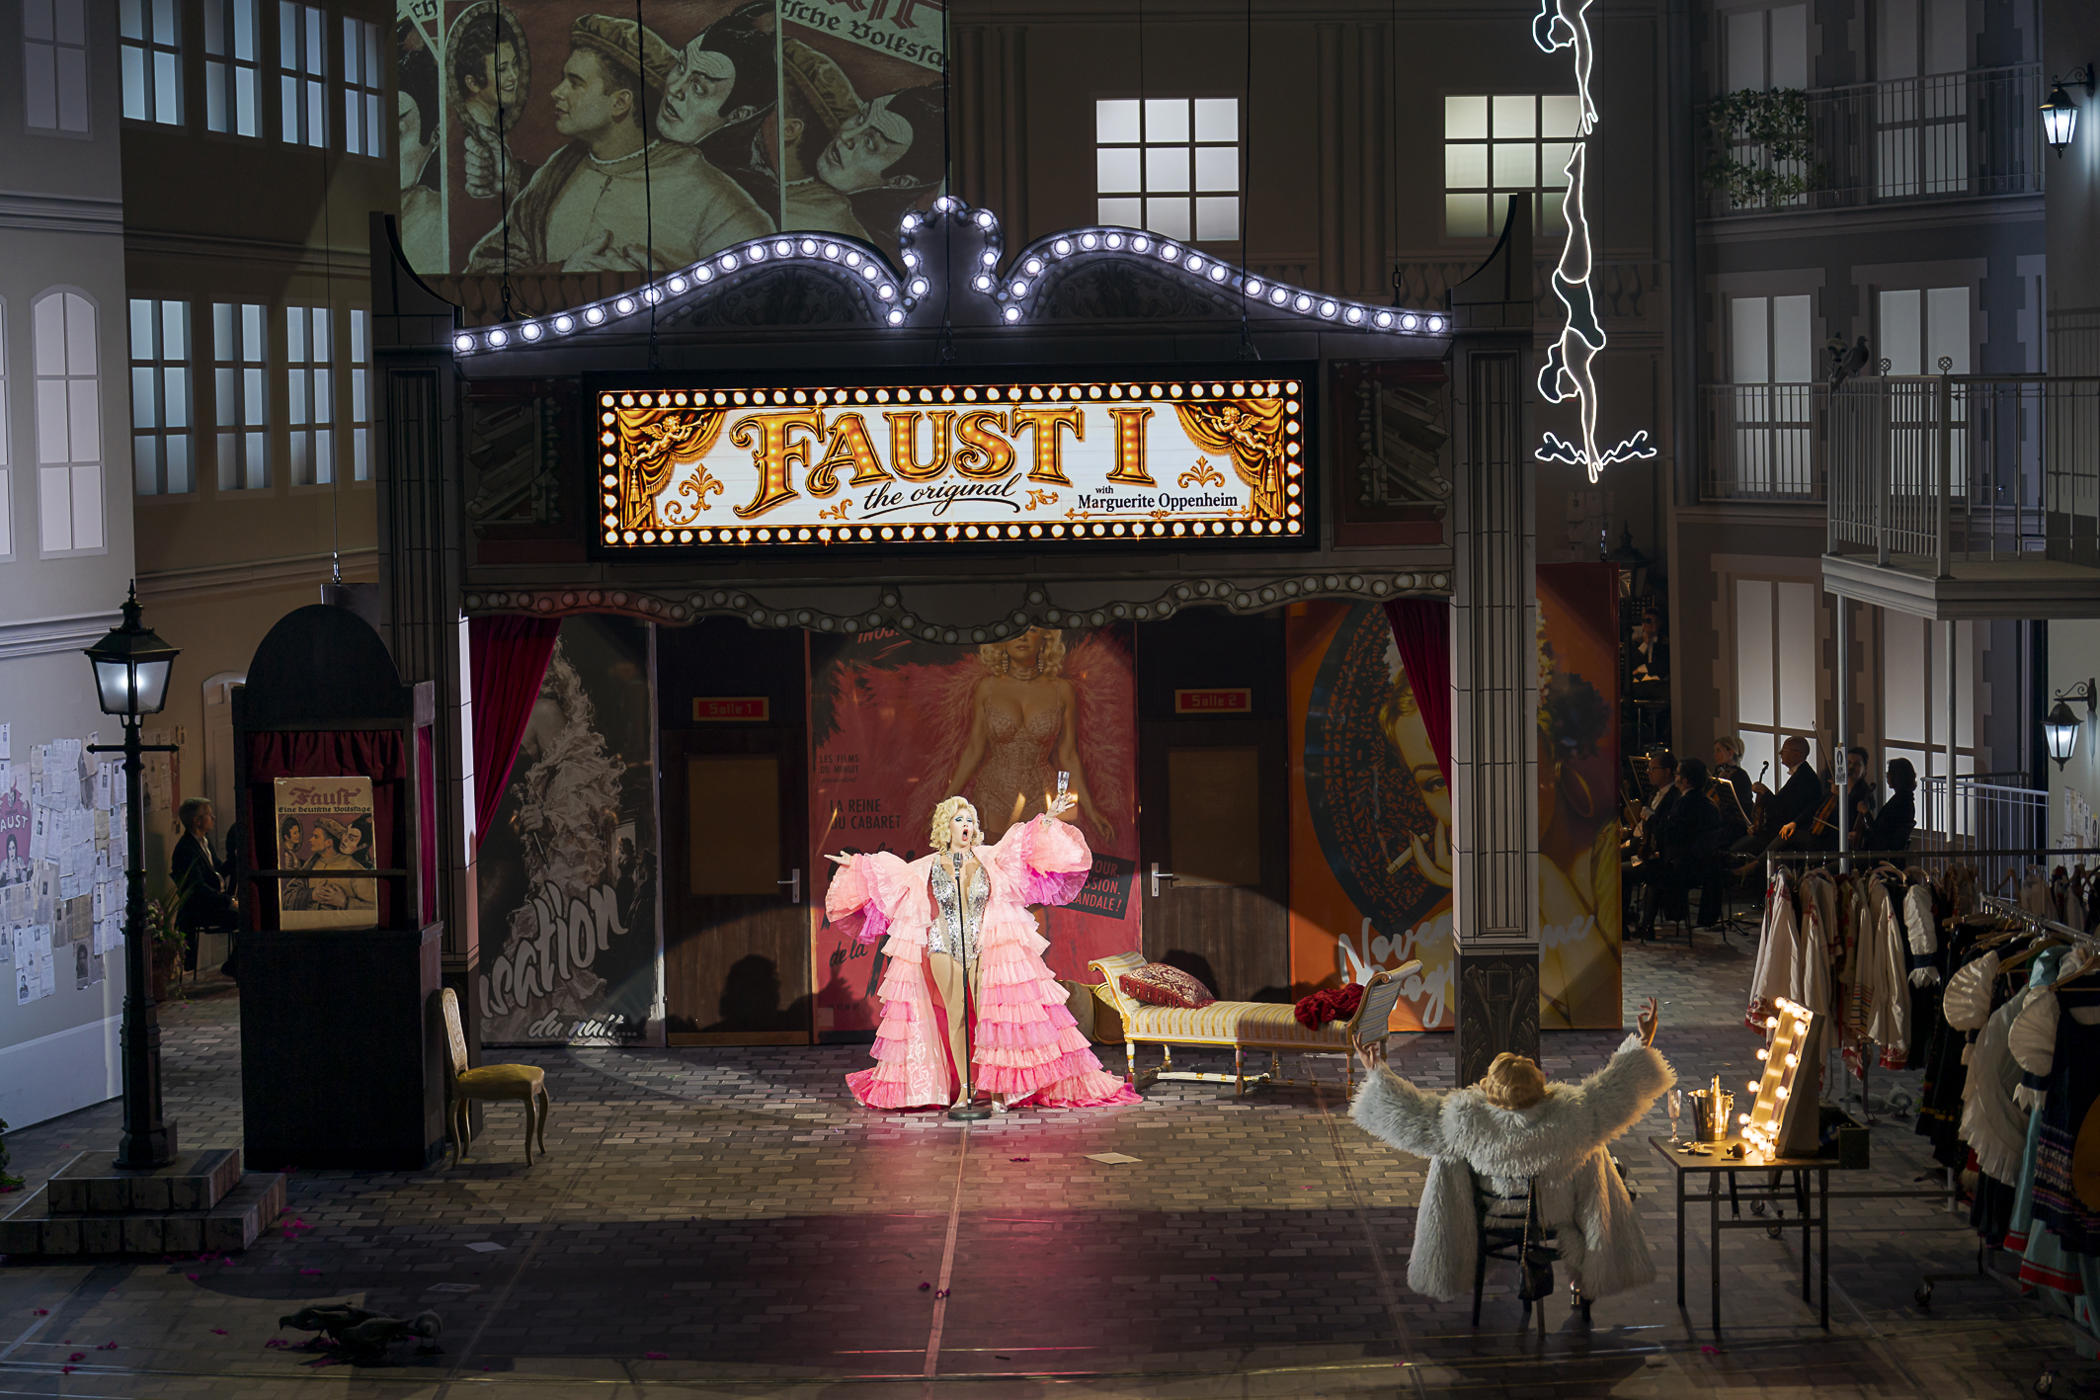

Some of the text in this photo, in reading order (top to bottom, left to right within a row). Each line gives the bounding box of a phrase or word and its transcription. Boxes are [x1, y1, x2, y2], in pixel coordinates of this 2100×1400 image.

[730, 404, 1157, 520] FAUST I
[863, 473, 1023, 517] the original
[1095, 485, 1114, 495] with
[1078, 492, 1238, 512] Marguerite Oppenheim
[709, 703, 743, 714] Salle
[1192, 694, 1238, 706] Salle 2
[830, 798, 881, 813] LA REINE
[850, 815, 900, 830] CABARET
[829, 938, 868, 968] de la
[528, 1008, 563, 1038] du
